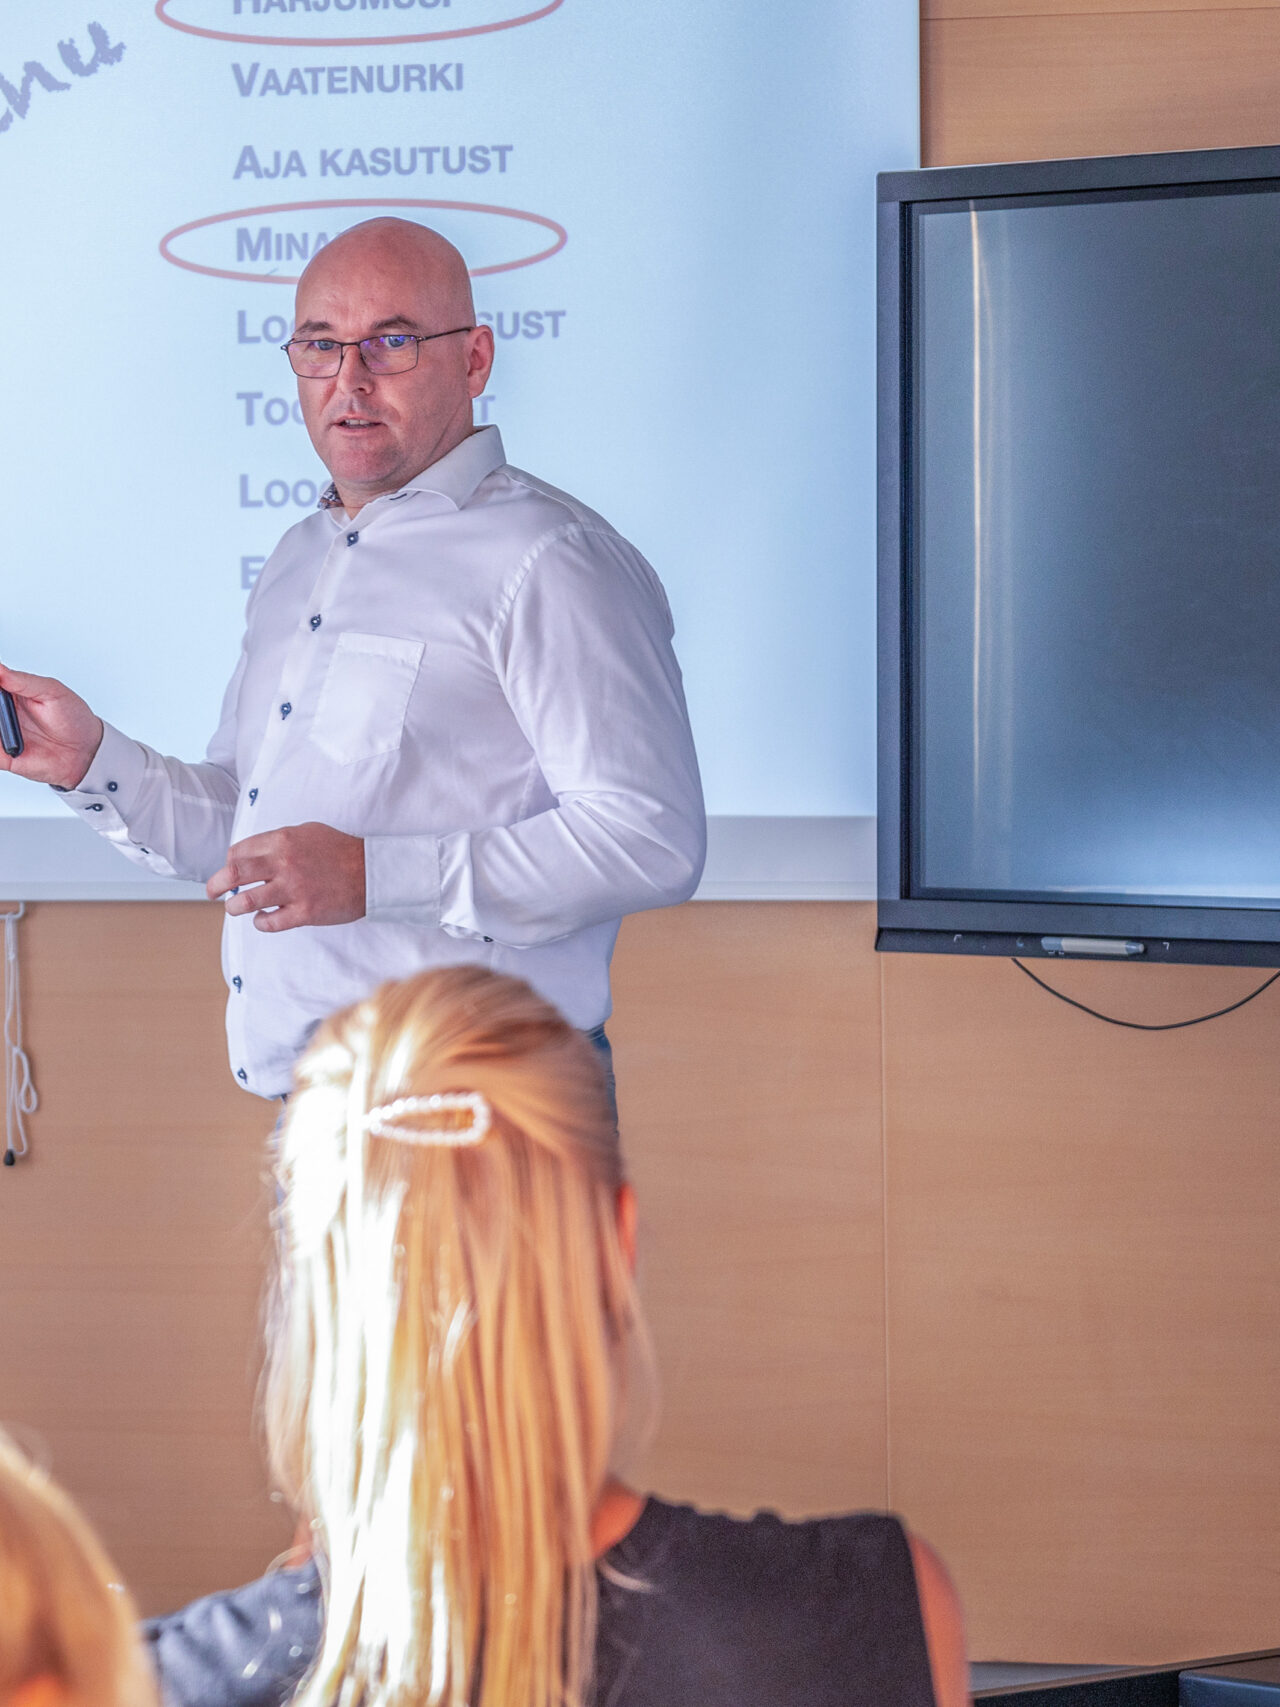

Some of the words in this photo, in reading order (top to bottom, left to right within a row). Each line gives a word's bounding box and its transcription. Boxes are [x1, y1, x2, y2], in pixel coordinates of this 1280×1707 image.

[232, 62, 464, 97] VAATENURKI
[232, 145, 307, 180] AJA
[320, 144, 513, 177] KASUTUST
